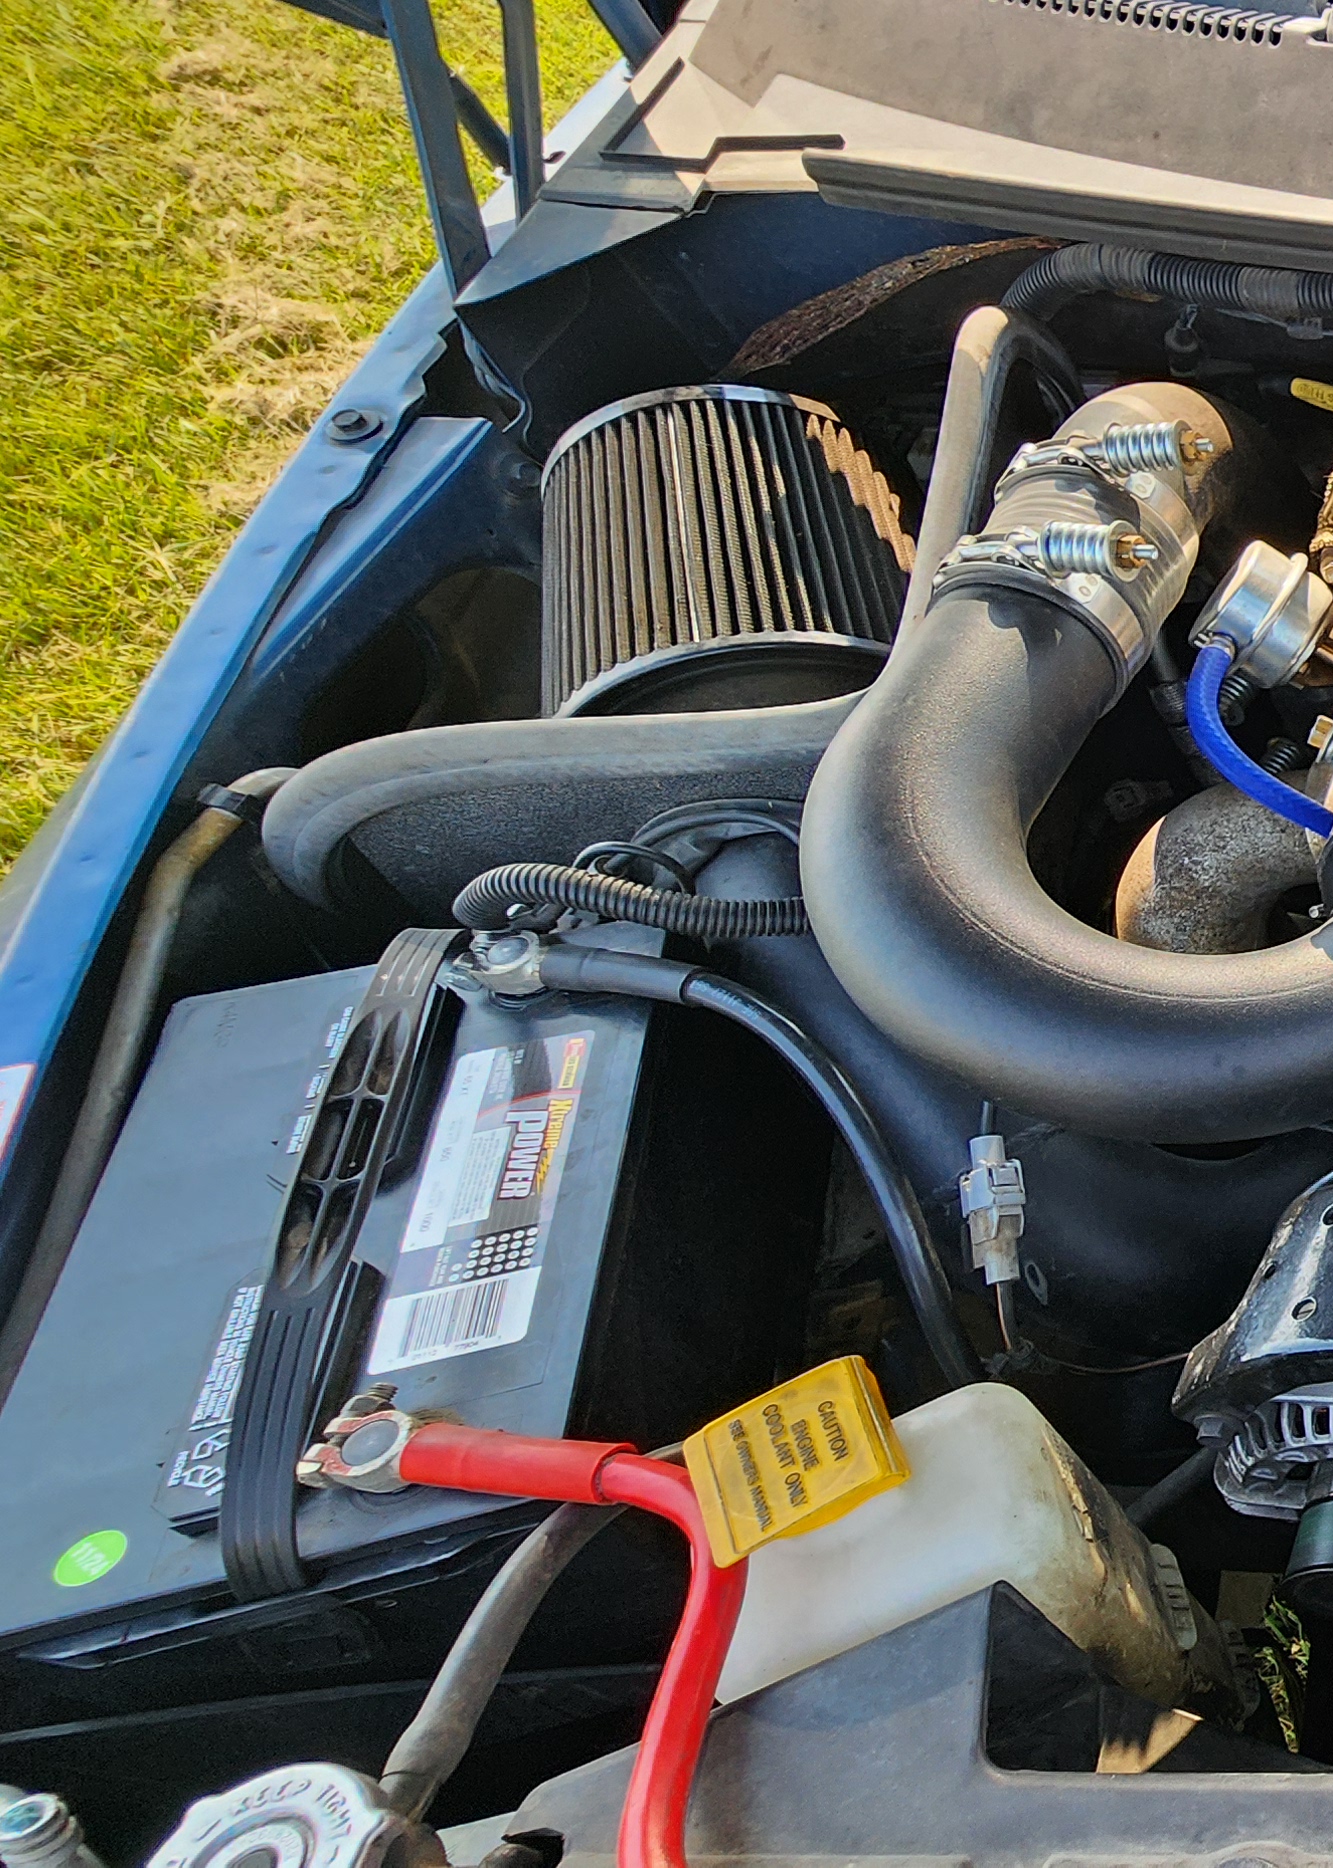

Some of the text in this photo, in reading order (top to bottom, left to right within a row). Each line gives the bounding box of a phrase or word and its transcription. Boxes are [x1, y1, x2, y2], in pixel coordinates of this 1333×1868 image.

[499, 1109, 549, 1200] POWER
[549, 1098, 574, 1149] Xtreme
[762, 1403, 808, 1508] COOLANT ONLY
[790, 1418, 820, 1472] ENGINE
[818, 1400, 849, 1462] CAUTION
[728, 1418, 773, 1532] SEE OWNERS MANUAL
[70, 1541, 110, 1576] 11/24
